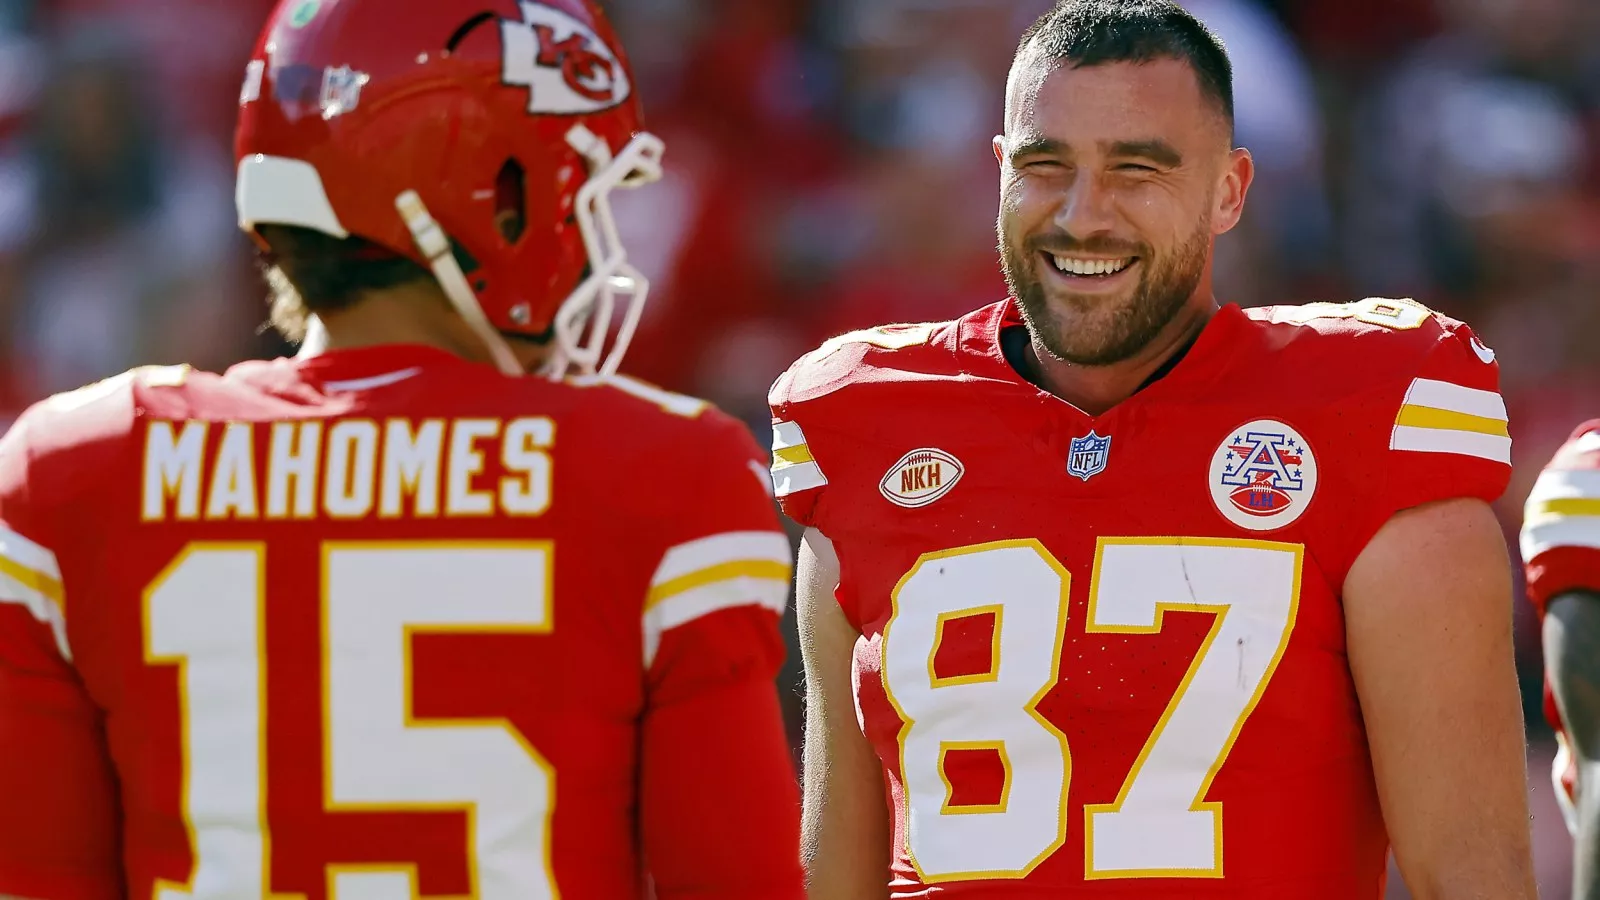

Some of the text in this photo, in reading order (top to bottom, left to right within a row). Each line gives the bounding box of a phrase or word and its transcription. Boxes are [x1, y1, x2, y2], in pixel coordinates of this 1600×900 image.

[141, 416, 556, 521] MAHOMES
[900, 462, 941, 494] NKH
[1073, 452, 1100, 471] NFL
[1221, 432, 1303, 491] A
[1248, 492, 1274, 508] LH
[141, 540, 561, 900] 15
[881, 536, 1305, 884] 87
